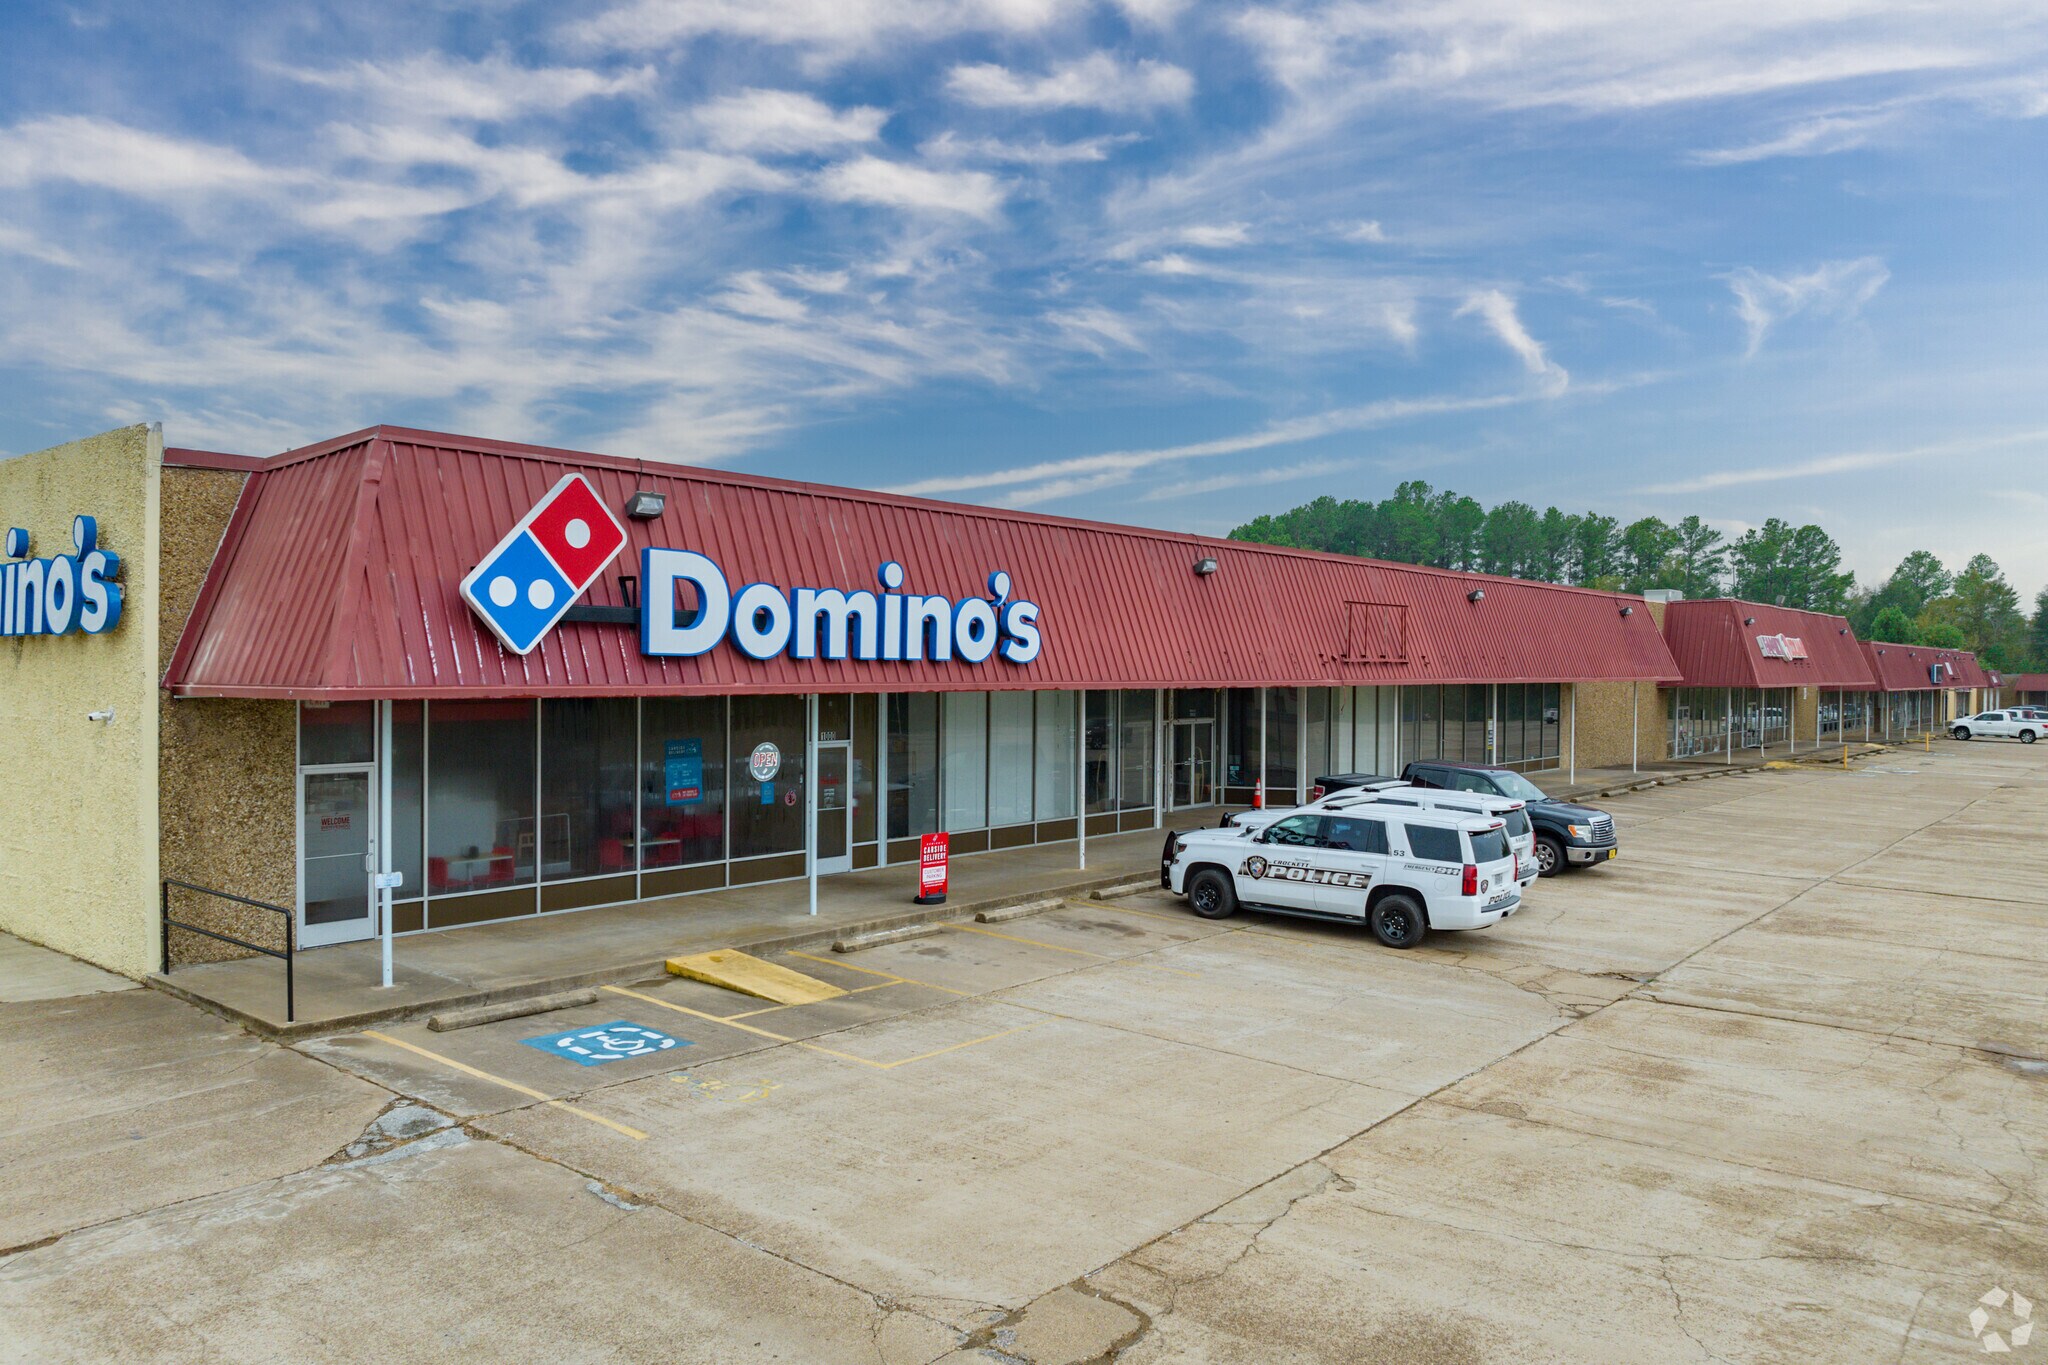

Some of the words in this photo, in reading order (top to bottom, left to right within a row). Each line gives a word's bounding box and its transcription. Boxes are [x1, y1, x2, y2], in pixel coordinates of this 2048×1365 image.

[0, 515, 120, 636] ino's
[641, 547, 1041, 663] Domino's
[753, 752, 778, 767] OPEN
[321, 817, 350, 825] WELCOME
[923, 844, 947, 854] CARSIDE
[923, 852, 946, 862] DELIVERY
[1273, 859, 1310, 868] CROCKETT
[1268, 865, 1366, 888] POLICE
[1488, 890, 1512, 904] POLICE
